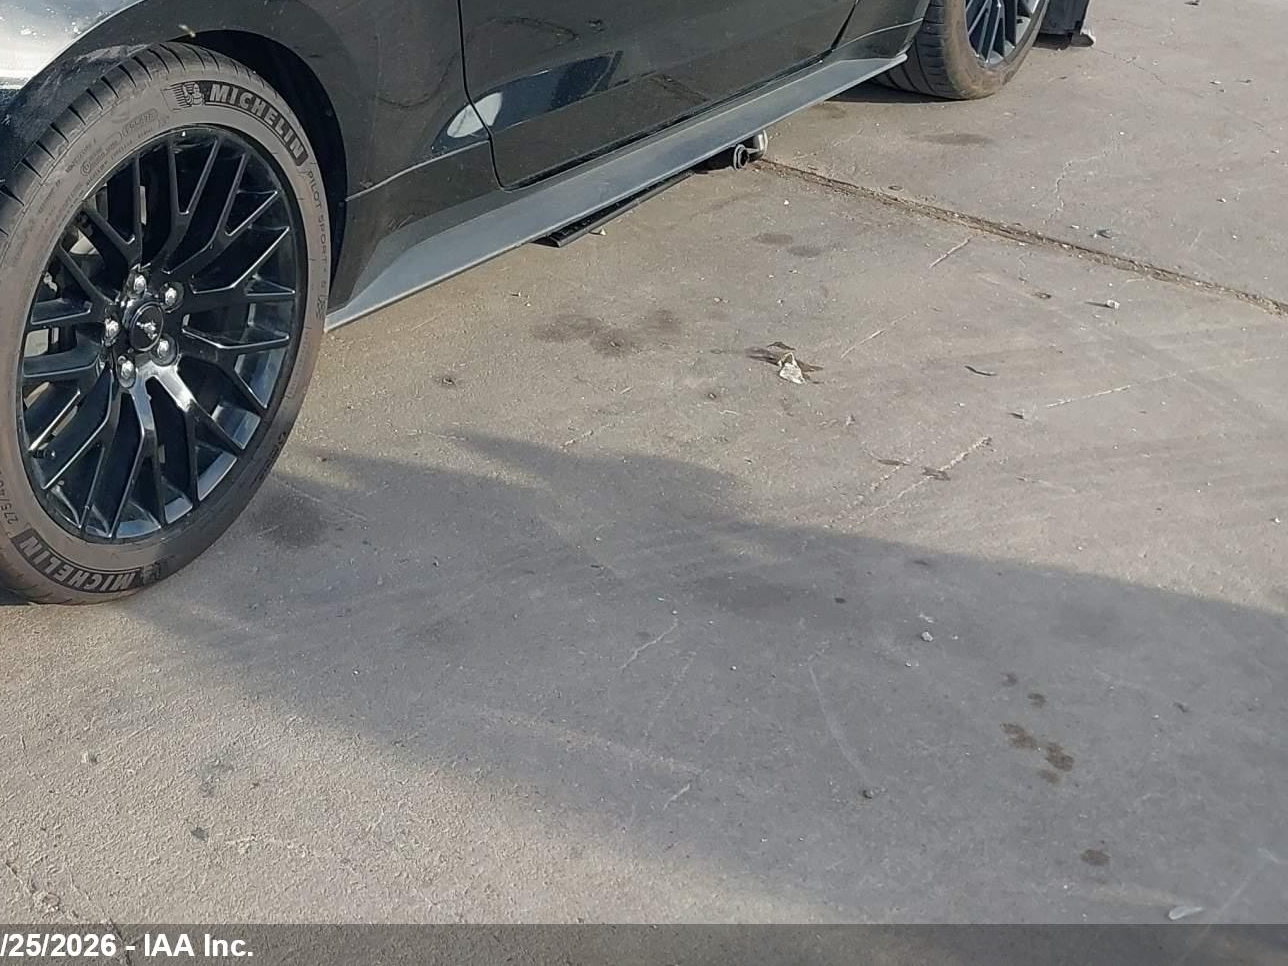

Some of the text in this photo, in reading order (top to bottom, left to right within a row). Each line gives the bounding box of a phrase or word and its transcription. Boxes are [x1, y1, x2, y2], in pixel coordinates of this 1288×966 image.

[210, 84, 304, 159] MICHELIN
[308, 171, 322, 209] PILOT
[318, 214, 327, 263] SPORT
[20, 535, 136, 591] MICHELIN
